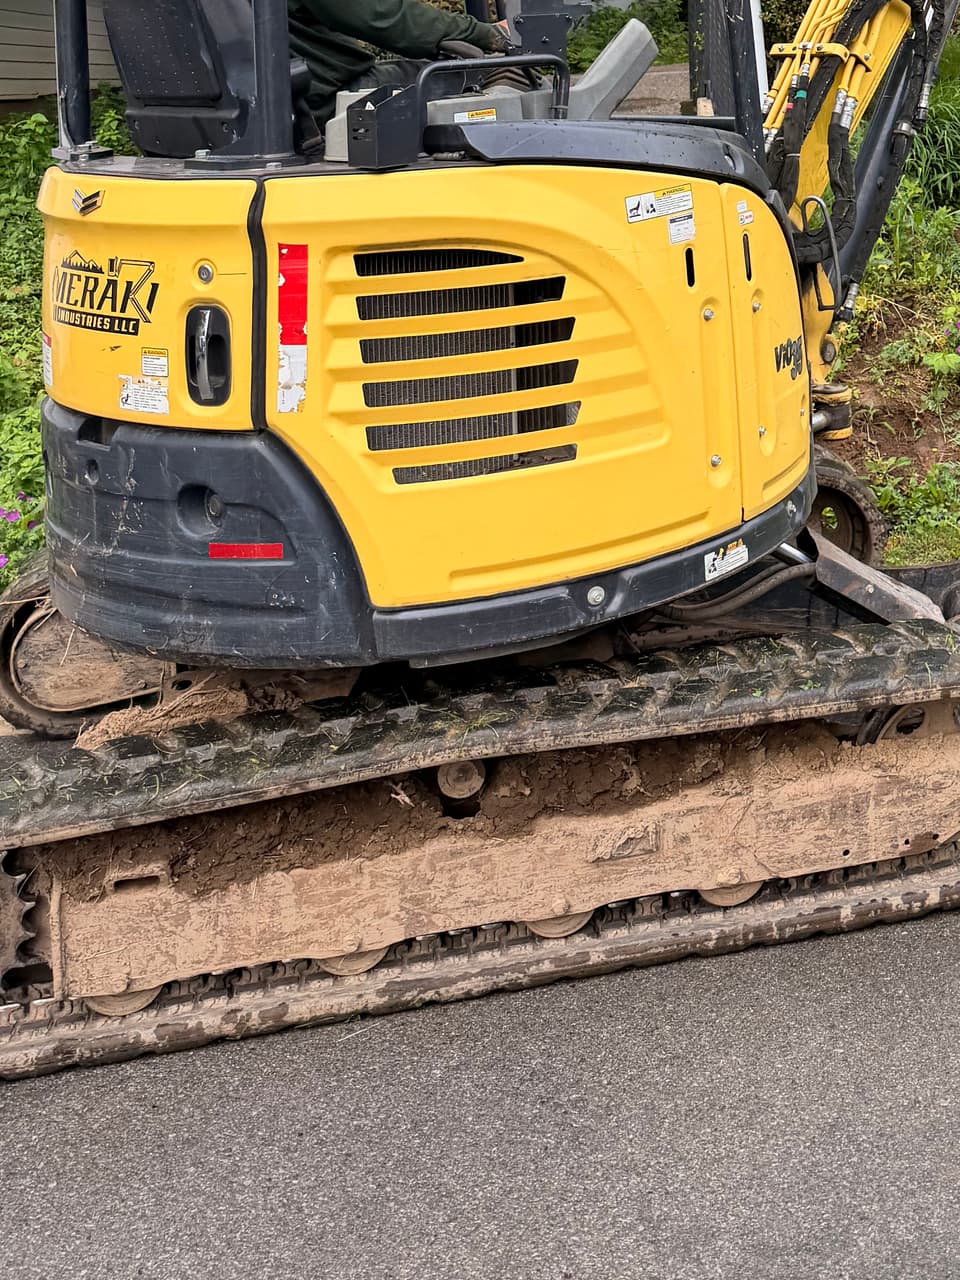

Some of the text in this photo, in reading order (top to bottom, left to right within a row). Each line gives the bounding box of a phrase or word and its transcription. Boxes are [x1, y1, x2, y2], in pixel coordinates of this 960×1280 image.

[52, 265, 159, 323] MERAKI
[57, 308, 137, 333] INDUSTRIES LLC
